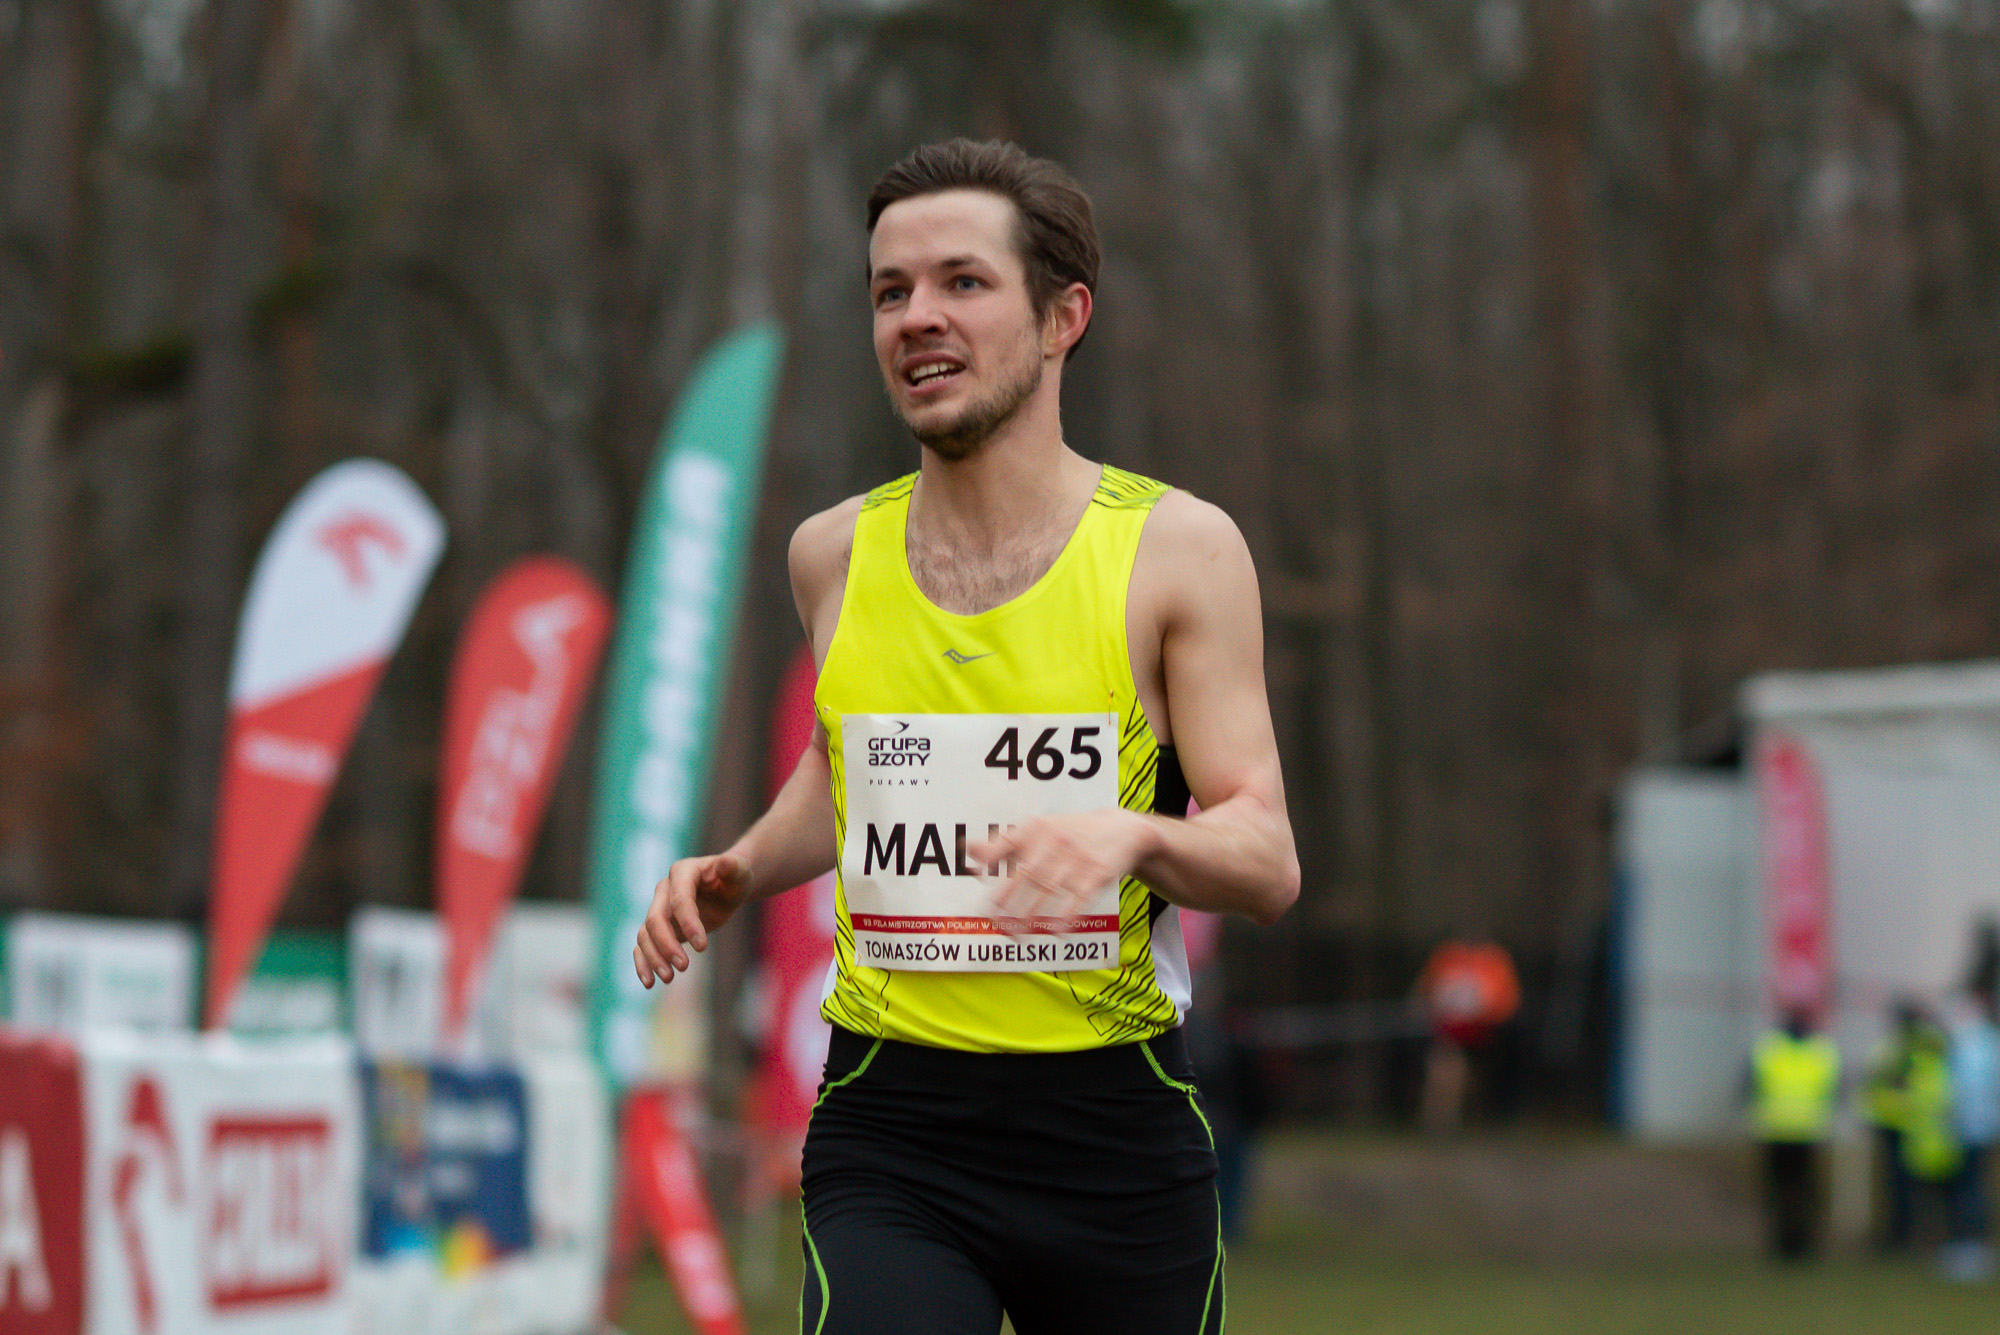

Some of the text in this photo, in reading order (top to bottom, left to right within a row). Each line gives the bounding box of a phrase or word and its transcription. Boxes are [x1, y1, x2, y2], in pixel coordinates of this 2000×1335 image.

[984, 726, 1103, 781] 465
[888, 920, 945, 930] MISTRZOSTWA
[947, 921, 979, 930] POLSKI
[980, 921, 990, 930] W
[865, 938, 1109, 962] TOMASZÓW LUBELSKI 2021
